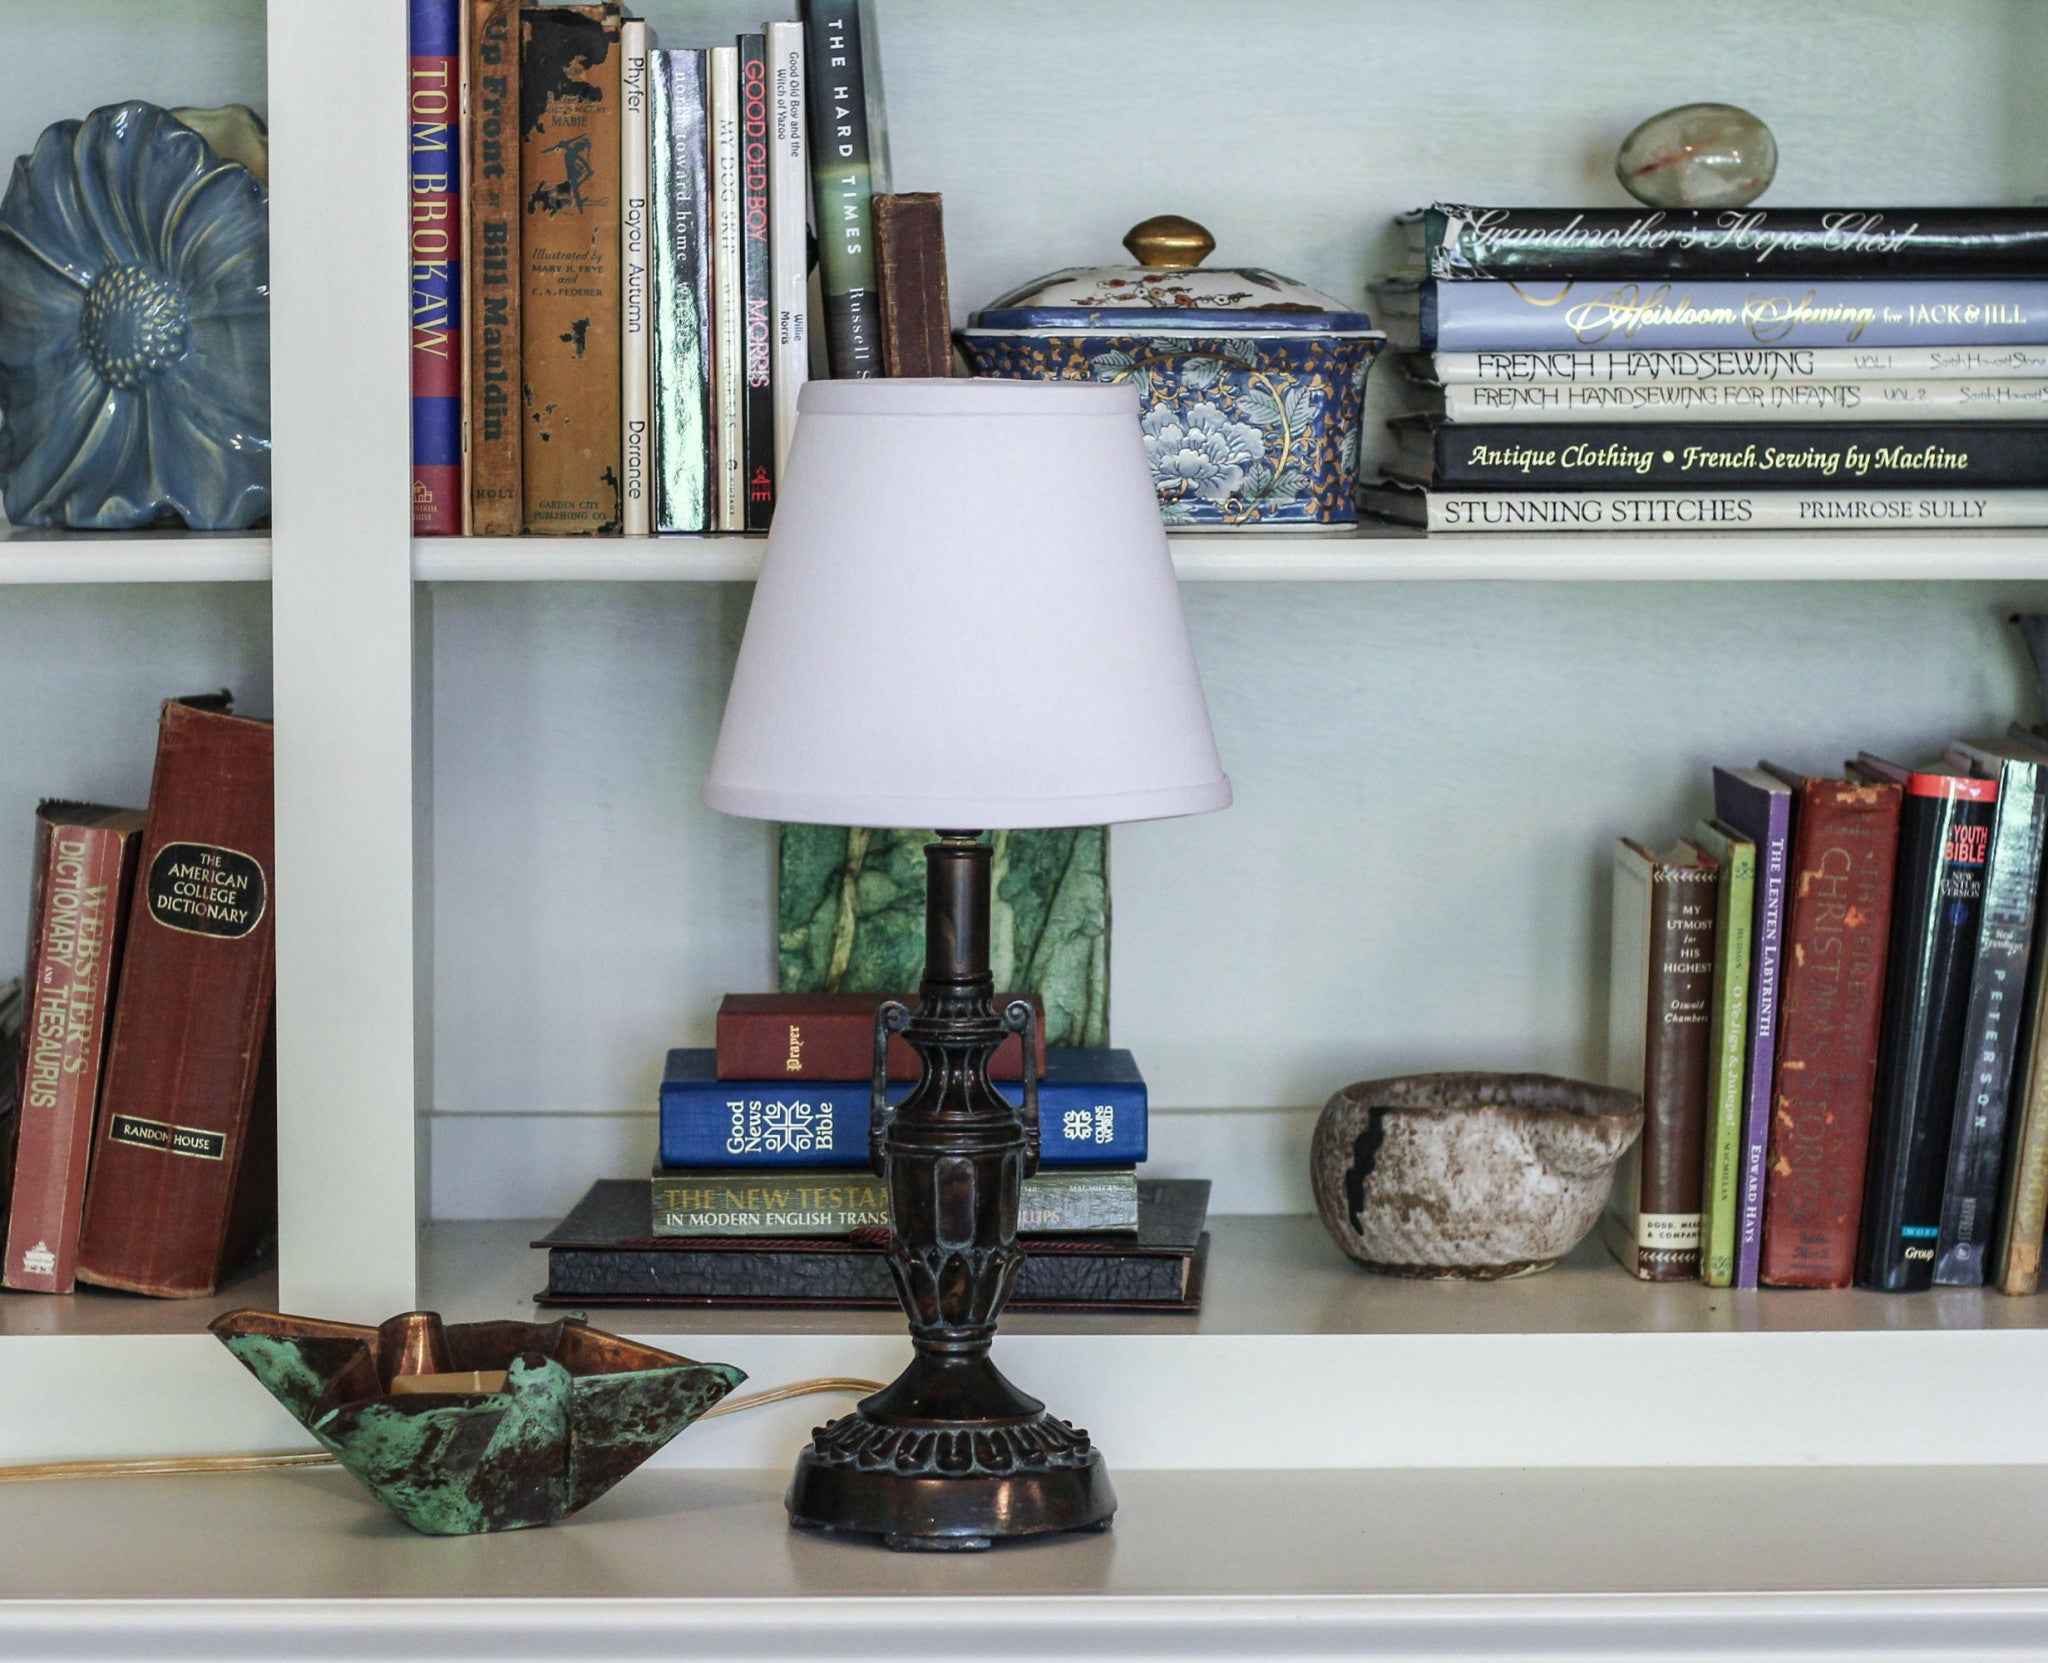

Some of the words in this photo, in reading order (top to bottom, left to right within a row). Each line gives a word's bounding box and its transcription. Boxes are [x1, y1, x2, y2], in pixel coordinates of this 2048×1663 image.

[828, 19, 845, 68] THE
[789, 52, 799, 77] Good
[624, 58, 645, 113] Phyfer
[745, 60, 766, 137] GOOD
[777, 68, 787, 97] Witch
[790, 80, 800, 97] Old
[412, 61, 448, 152] TOM
[778, 99, 787, 109] of
[789, 101, 800, 119] Boy
[483, 76, 507, 178] Front
[777, 111, 787, 141] Yazoo
[790, 122, 800, 138] and
[833, 86, 853, 158] HARD
[790, 141, 801, 158] the
[675, 134, 692, 202] toward
[720, 157, 736, 202] DOG
[747, 143, 767, 190] OLD
[624, 198, 645, 253] Bayou
[747, 197, 768, 242] BOY
[841, 175, 862, 255] TIMES
[676, 212, 693, 261] home
[1472, 209, 1702, 251] Grandmother's
[1704, 211, 1818, 262] Hope
[1821, 213, 1919, 252] Chest
[412, 173, 449, 360] BROKAW
[484, 223, 508, 285] Bill
[532, 248, 590, 260] Illustrated
[532, 264, 562, 272] MARY
[558, 274, 578, 284] and
[629, 263, 645, 333] Autumn
[1565, 283, 1737, 343] Heirloom
[1742, 288, 1876, 343] Sewing
[1884, 305, 1903, 324] for
[1909, 304, 1962, 325] JACK
[1965, 305, 1981, 325] &
[1984, 303, 2027, 325] JILL
[780, 311, 790, 345] Morris
[794, 314, 803, 341] Willie
[849, 287, 870, 359] Russell
[749, 299, 770, 387] MORRIS
[483, 297, 508, 441] Mauldin
[1478, 352, 1595, 381] FRENCH
[1609, 351, 1814, 381] HANDSEWING
[1474, 387, 1558, 407] FRENCH
[1569, 386, 1717, 409] HANDSEWING
[1724, 387, 1764, 408] FOR
[1771, 386, 1861, 408] INFANTS
[629, 421, 646, 500] Dorrance
[1468, 445, 1556, 474] Antique
[1561, 444, 1654, 474] Clothing
[1681, 445, 1757, 469] French
[1759, 447, 1840, 475] Sewing
[1845, 445, 1871, 476] by
[1874, 446, 1969, 469] Machine
[477, 489, 513, 498] HOLT
[538, 501, 576, 510] GARDEN
[579, 501, 599, 510] CITY
[535, 512, 588, 520] PUBLISHING
[1445, 500, 1602, 523] STUNNING
[1611, 499, 1753, 523] STITCHES
[1800, 500, 1913, 519] PRIMROSE
[1919, 500, 1988, 519] SULLY
[1953, 825, 1989, 843] YOUTH
[201, 853, 222, 867] THE
[1769, 838, 1785, 873] THE
[1945, 840, 1986, 863] BIBLE
[168, 864, 248, 890] AMERICAN
[1952, 871, 1974, 880] NEW
[47, 841, 86, 967] DICTIONARY
[174, 881, 237, 905] COLLEGE
[1940, 887, 1981, 897] VERSION
[157, 896, 248, 924] DICTIONARY
[1667, 920, 1712, 930] UTMOST
[1682, 905, 1702, 915] MY
[1765, 878, 1782, 940] LENTEN
[1681, 949, 1700, 958] HIS
[1683, 934, 1697, 944] for
[1736, 927, 1744, 969] HUDSON
[1806, 847, 1852, 1056] CHRISTMAS
[43, 967, 54, 983] AND
[64, 883, 107, 1074] WEBSTER'S
[1664, 963, 1712, 973] HIGHEST
[1671, 1000, 1705, 1010] Oswald
[1733, 985, 1743, 997] O
[1759, 945, 1779, 1037] LABYRINTH
[1664, 1013, 1709, 1023] Chambers
[1731, 1001, 1743, 1018] Ye
[31, 985, 68, 1108] THESAURUS
[787, 1025, 804, 1072] Prayer
[1727, 1019, 1741, 1051] Jigs
[1974, 968, 2006, 1128] PETERSON
[1727, 1055, 1739, 1067] &
[727, 1100, 745, 1154] Good
[745, 1101, 761, 1152] News
[816, 1102, 833, 1150] Bible
[1095, 1105, 1104, 1144] COLLINS
[1104, 1105, 1114, 1143] WORLD
[173, 1134, 210, 1150] HOUSE
[1721, 1143, 1731, 1201] MACMILLAN
[1747, 1145, 1762, 1202] EDWARD
[666, 1190, 716, 1209] THE
[726, 1189, 790, 1209] NEW
[666, 1213, 685, 1226] IN
[690, 1213, 760, 1226] MODERN
[767, 1212, 832, 1225] ENGLISH
[838, 1212, 889, 1225] TRANS
[1745, 1206, 1757, 1242] HAYS
[1904, 1246, 1935, 1261] Group
